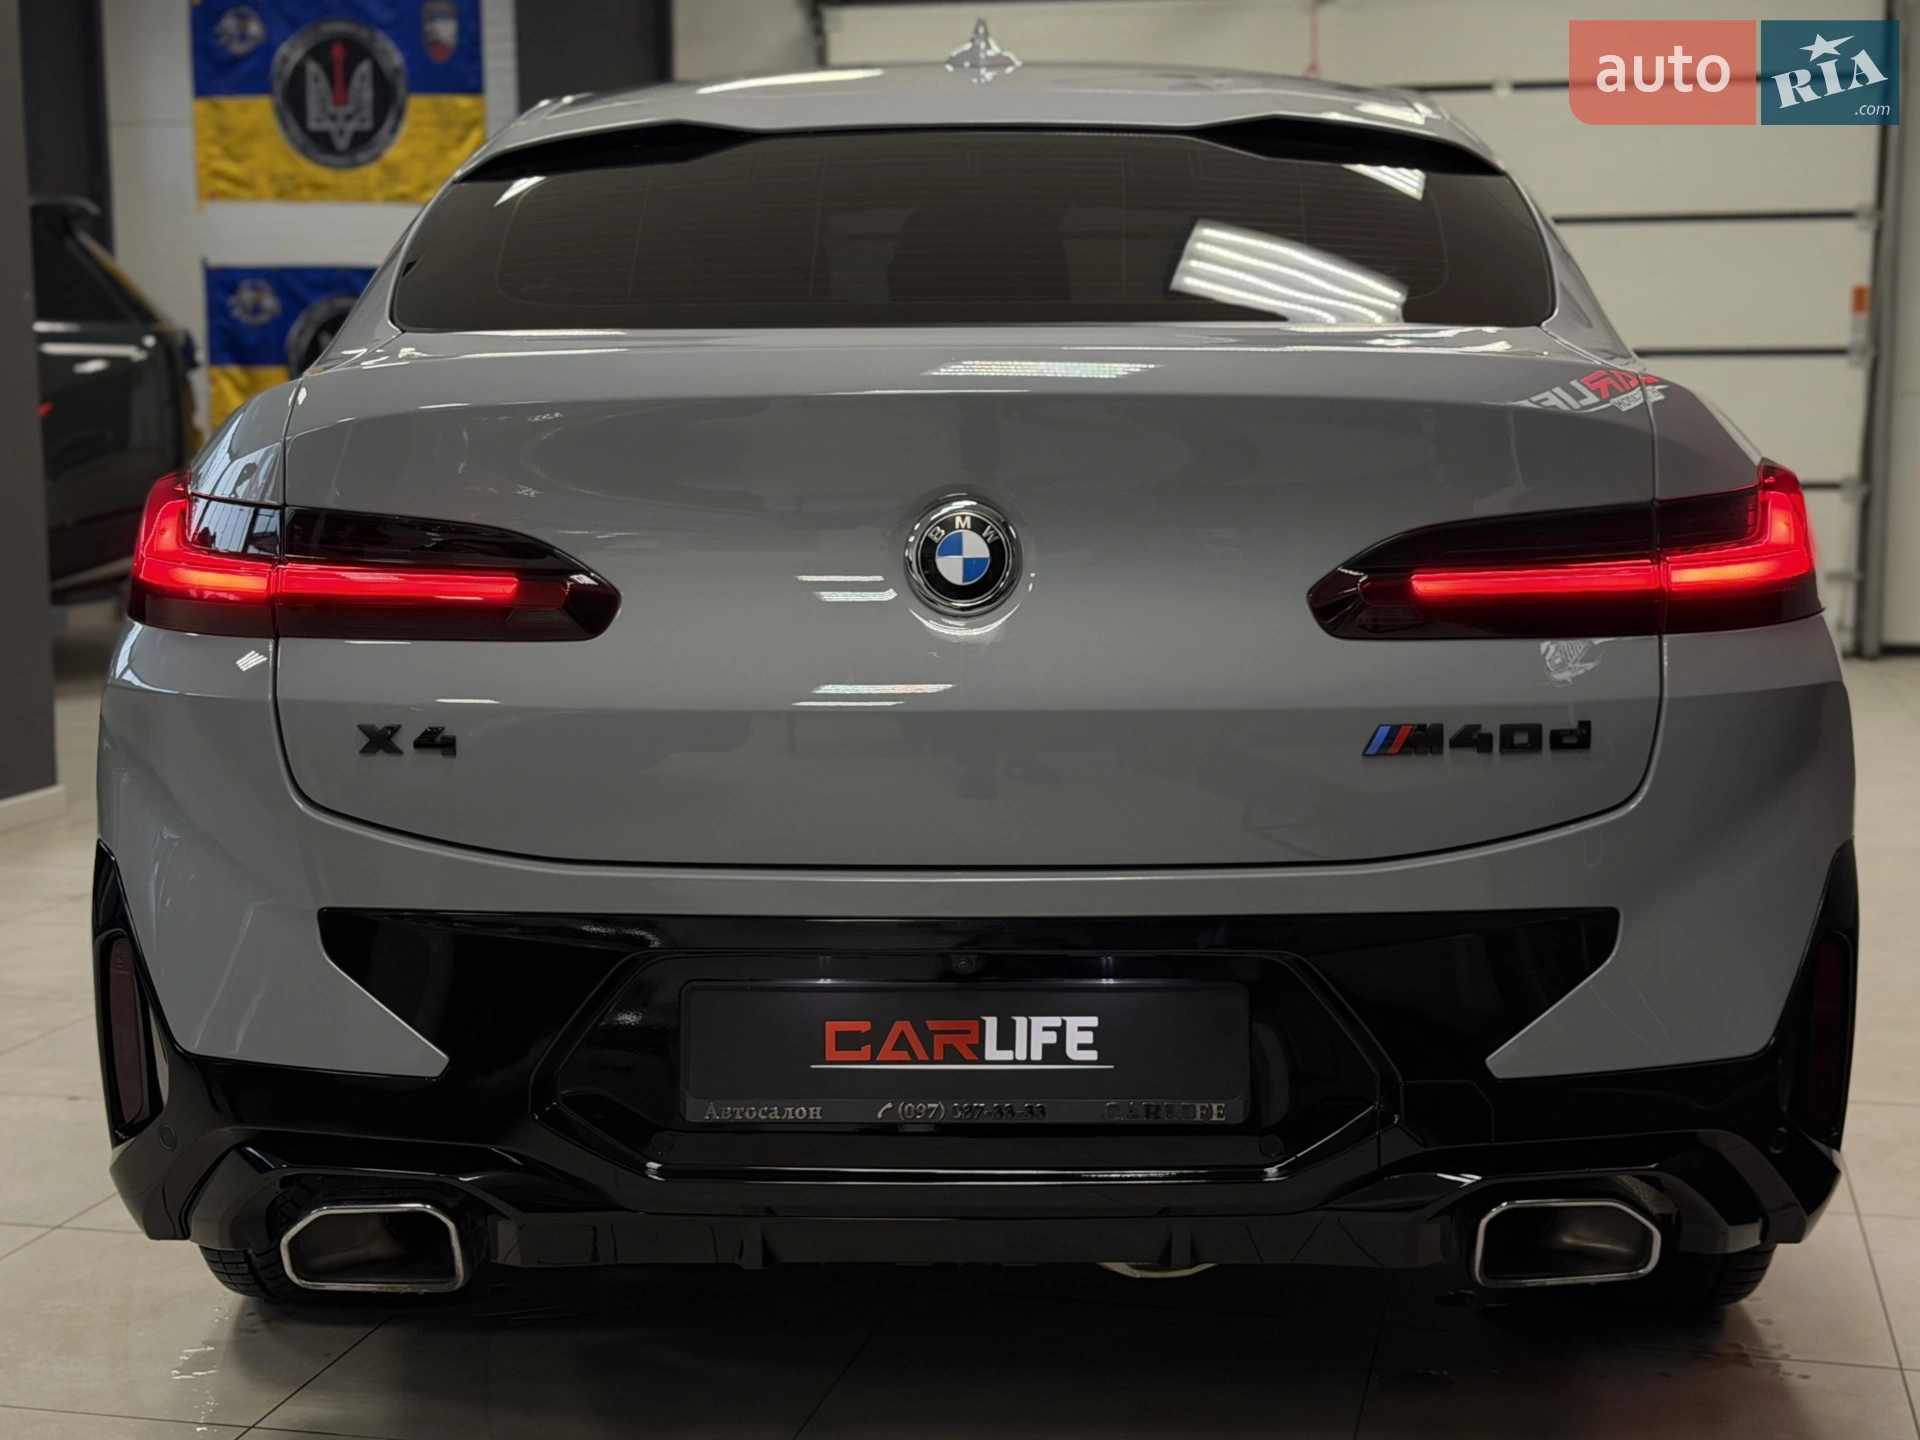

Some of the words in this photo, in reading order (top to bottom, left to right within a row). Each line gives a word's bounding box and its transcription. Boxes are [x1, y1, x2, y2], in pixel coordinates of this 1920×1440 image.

[927, 515, 1000, 544] BMW
[1363, 720, 1591, 755] M40d
[825, 1016, 1099, 1061] CARLIFE
[703, 1101, 823, 1120] Автосалон
[897, 1101, 946, 1120] (097)
